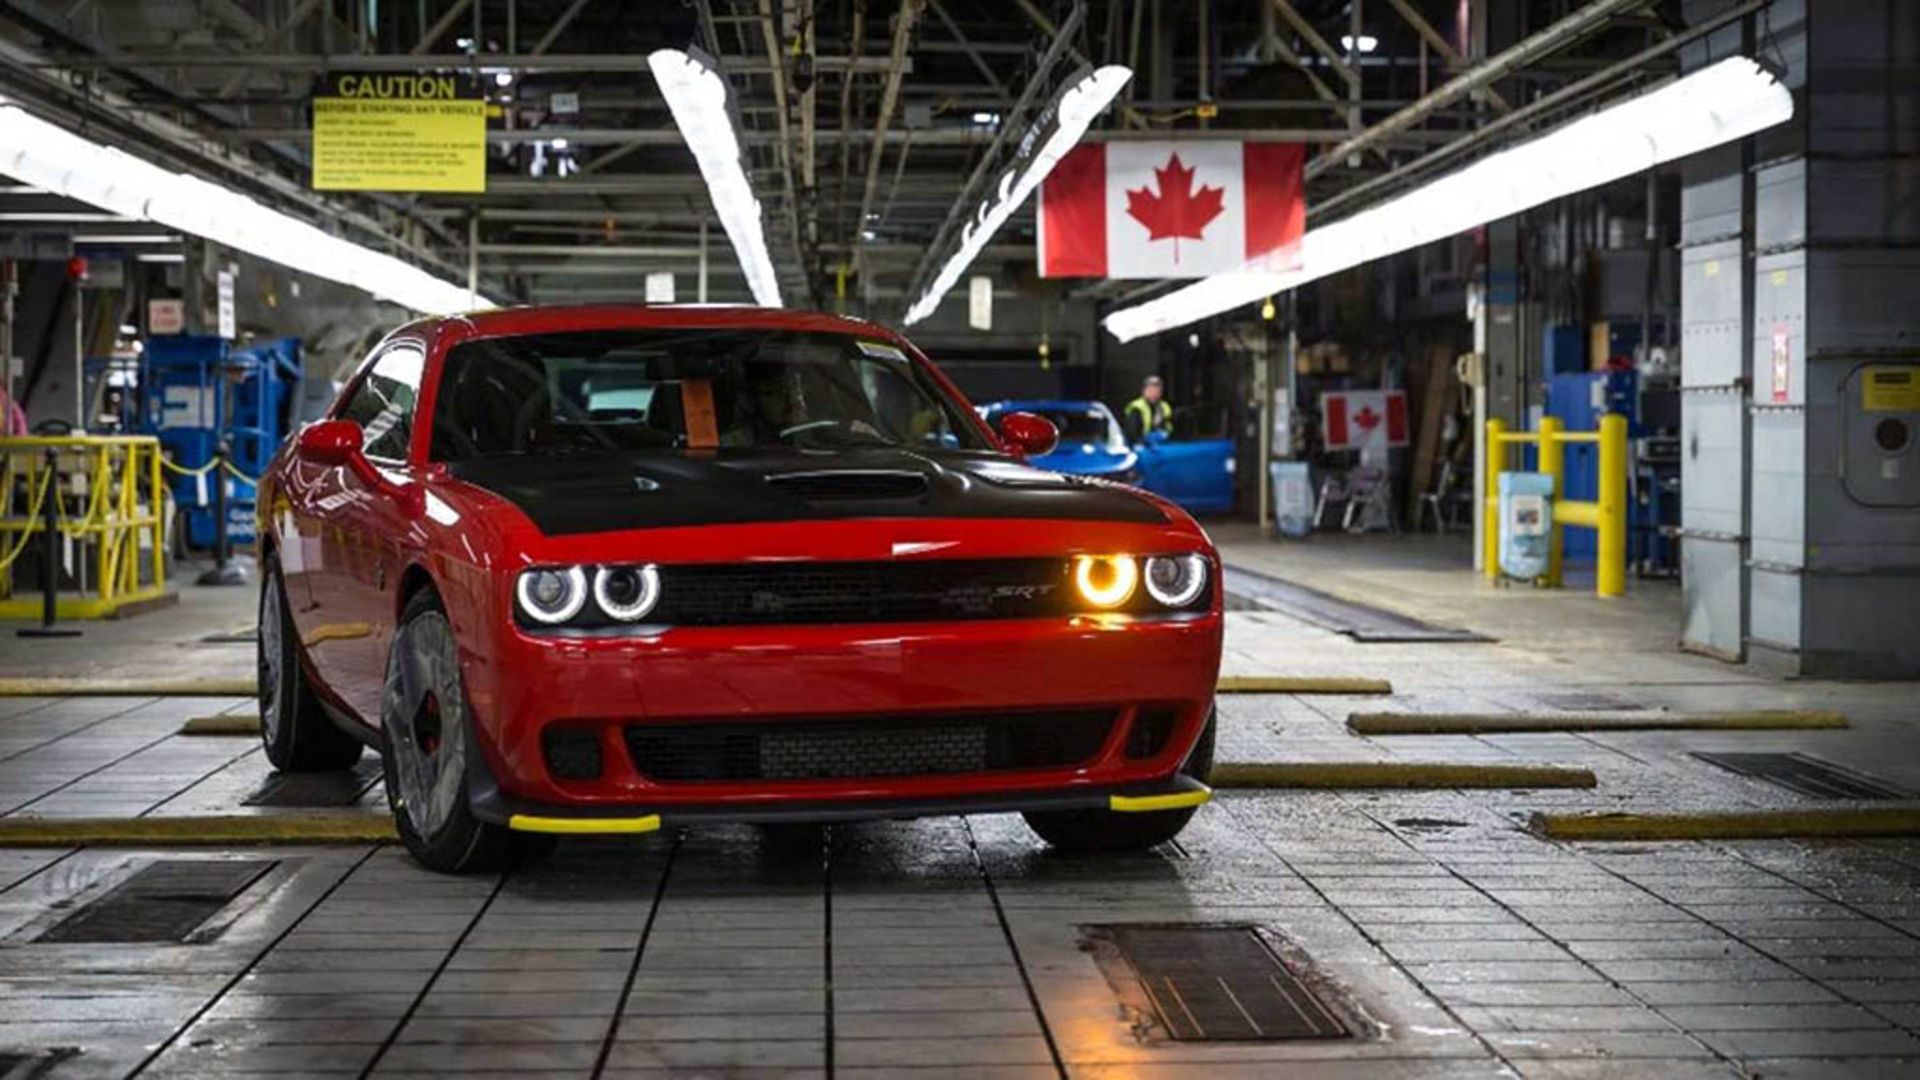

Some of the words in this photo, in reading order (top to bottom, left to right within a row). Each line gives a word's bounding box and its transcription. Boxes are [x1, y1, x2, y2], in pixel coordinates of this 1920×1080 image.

[338, 75, 456, 98] CAUTION
[440, 105, 483, 117] VEHICLE
[994, 584, 1057, 599] SRT
